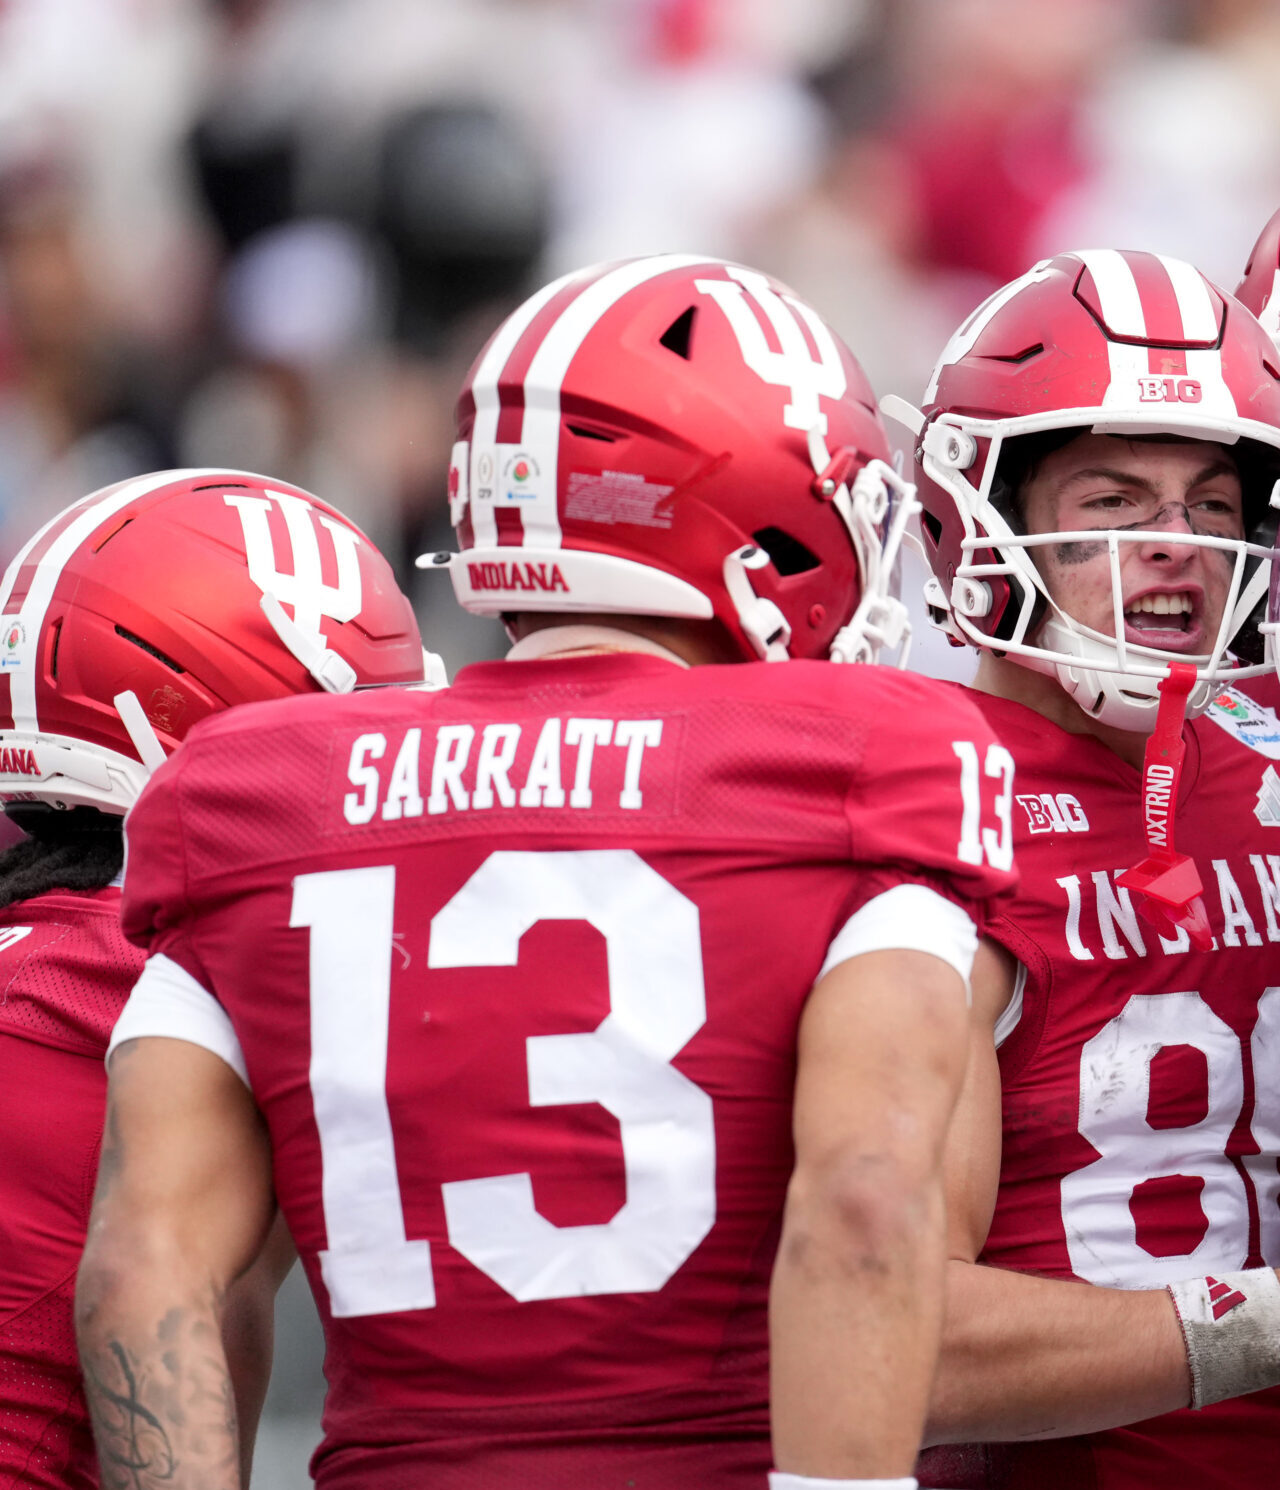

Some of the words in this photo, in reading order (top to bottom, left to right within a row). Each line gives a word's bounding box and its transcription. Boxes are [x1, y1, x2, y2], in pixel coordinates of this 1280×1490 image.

[467, 562, 570, 592] INDIANA
[343, 717, 663, 825] SARRATT
[951, 740, 1017, 873] 13
[1145, 763, 1175, 848] NXTRND
[288, 848, 718, 1319] 13
